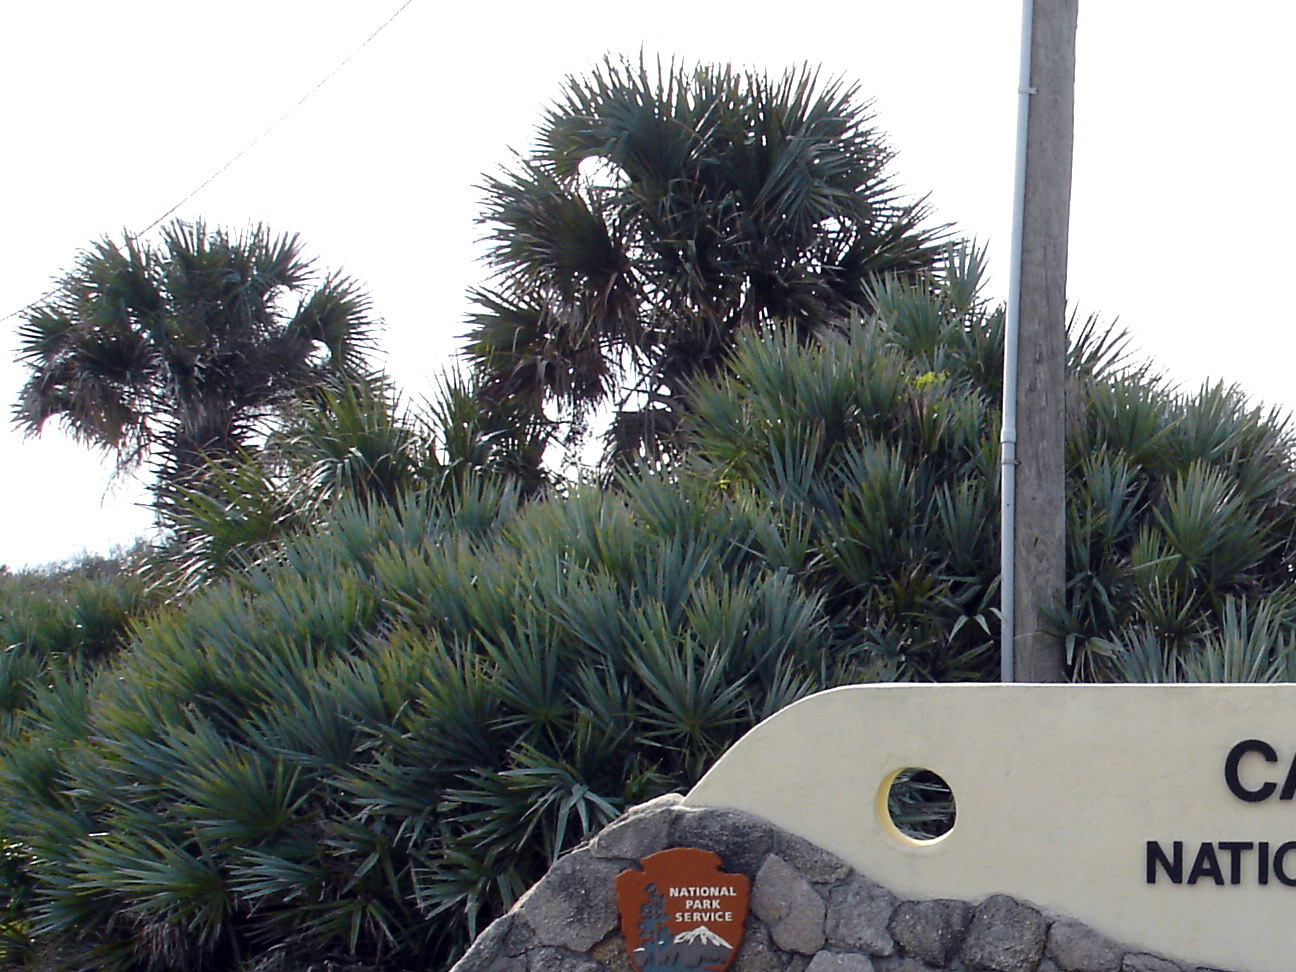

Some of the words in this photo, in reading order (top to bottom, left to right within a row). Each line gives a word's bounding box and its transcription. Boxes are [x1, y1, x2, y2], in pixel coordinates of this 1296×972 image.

[669, 886, 737, 897] NATIONAL
[685, 899, 721, 910] PARK
[675, 911, 733, 923] SERVICE
